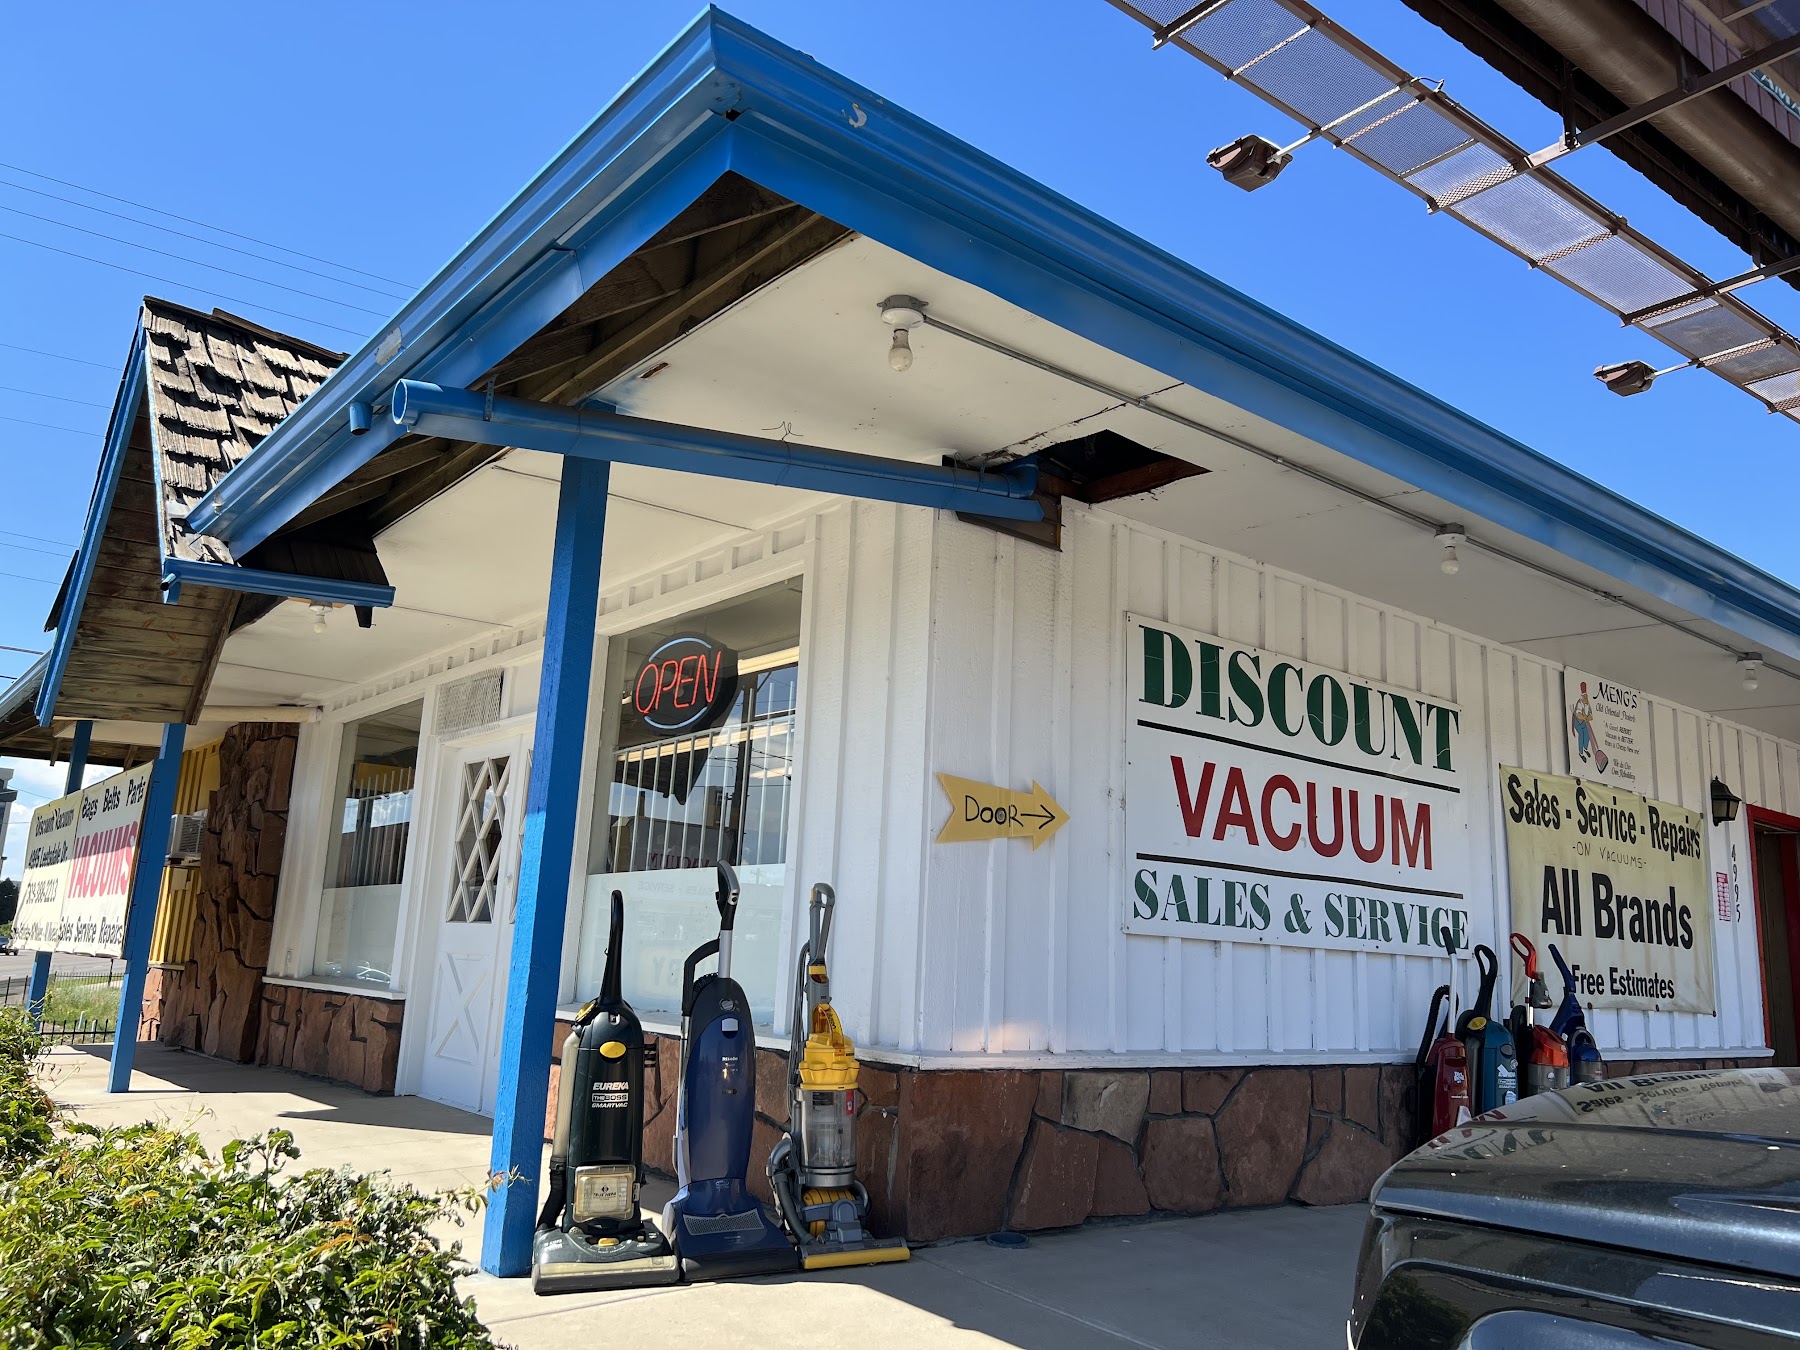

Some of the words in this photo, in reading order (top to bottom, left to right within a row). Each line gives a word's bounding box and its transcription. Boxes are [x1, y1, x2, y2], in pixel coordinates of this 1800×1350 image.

[635, 650, 722, 714] OPEN
[1138, 624, 1460, 773] DISCOUNT
[1592, 681, 1637, 709] MENG'S
[82, 796, 98, 821] Bags
[102, 786, 120, 813] Belts
[126, 776, 146, 807] Parts
[1170, 755, 1433, 870] VACUUM
[1507, 773, 1561, 830] Sales
[1577, 785, 1637, 846] Service
[1648, 805, 1701, 862] Repairs
[68, 820, 138, 899] VACUUMS
[1732, 844, 1740, 922] 4995
[58, 916, 74, 941] Sales
[74, 916, 97, 944] Service
[98, 916, 123, 950] Repairs
[1134, 868, 1271, 933] SALES
[1284, 893, 1314, 935] &
[1324, 892, 1470, 951] SERVICE
[1541, 866, 1582, 937] All
[1592, 872, 1694, 950] Brands
[1570, 964, 1604, 995] Free
[1609, 966, 1675, 1000] Estimates
[592, 1081, 629, 1090] EUREKA
